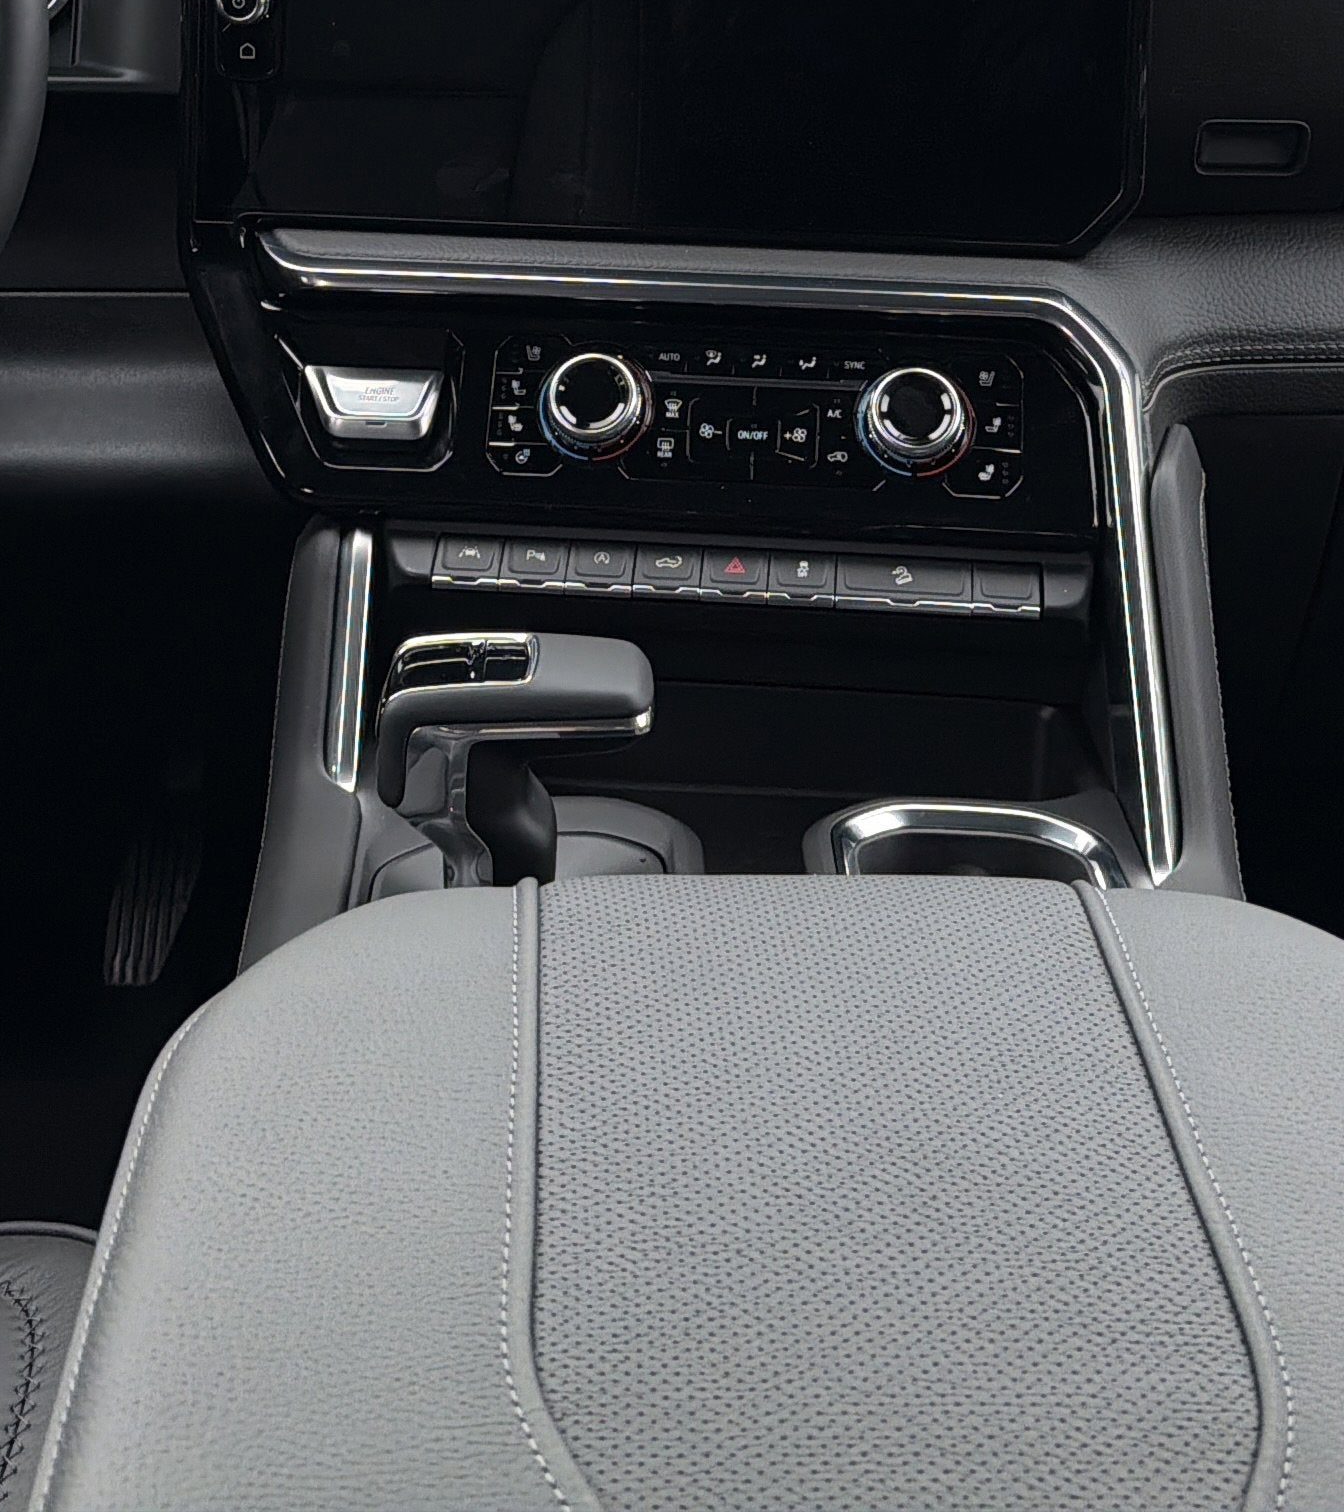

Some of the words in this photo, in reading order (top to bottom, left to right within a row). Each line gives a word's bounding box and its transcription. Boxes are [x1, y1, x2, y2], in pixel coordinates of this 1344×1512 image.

[658, 352, 681, 362] AUTO
[844, 360, 866, 370] SYNC
[364, 386, 394, 395] ENGINE
[827, 409, 843, 419] A/C
[737, 429, 769, 441] ON/OFF
